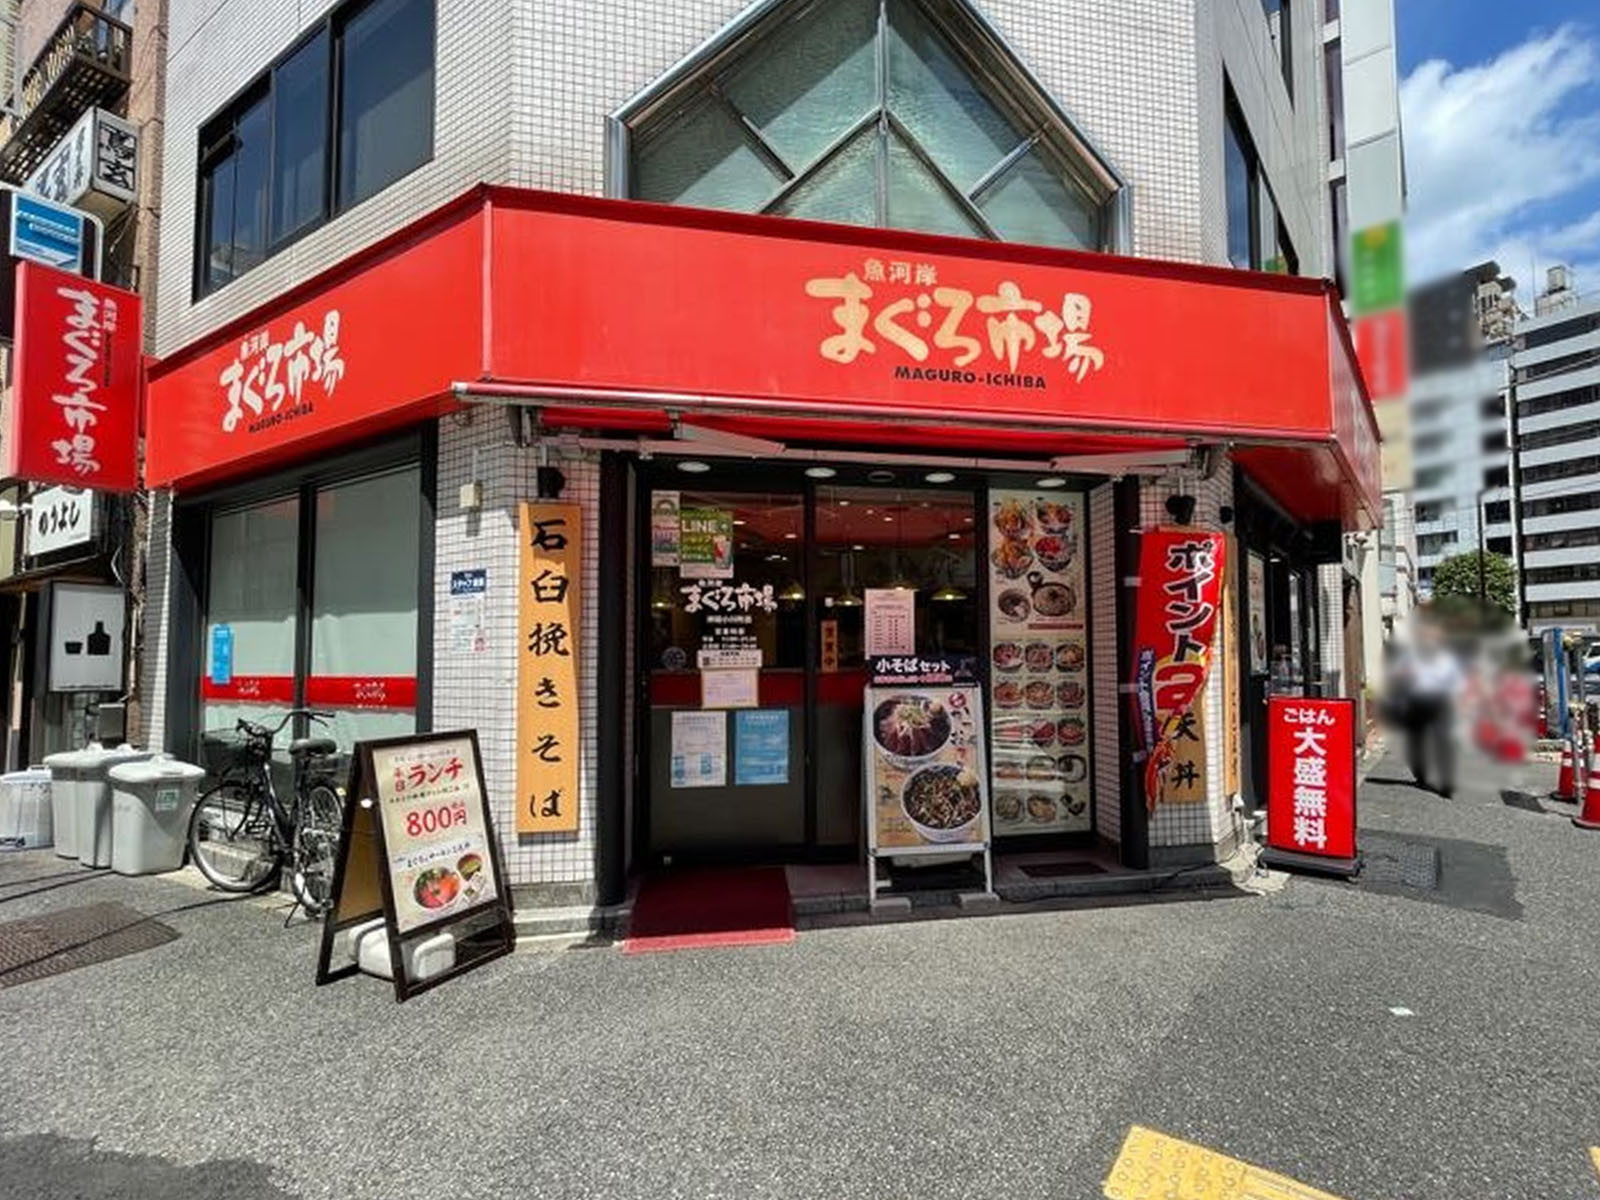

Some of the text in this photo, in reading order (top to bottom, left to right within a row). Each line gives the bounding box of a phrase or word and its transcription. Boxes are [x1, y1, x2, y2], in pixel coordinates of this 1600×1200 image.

[863, 257, 938, 287] 魚河岸
[804, 272, 1105, 384] まぐろ市場
[51, 287, 108, 475] まぐろ市場
[219, 309, 345, 432] まぐろ市場
[893, 365, 1047, 390] MAGURO-ICHIBA
[681, 519, 718, 533] LINE
[679, 582, 779, 614] まぐろ市場
[528, 518, 571, 819] 石臼挽きそば
[875, 657, 951, 673] 小そばセット
[1283, 707, 1336, 726] ごはん
[408, 757, 464, 789] ランチ
[1293, 726, 1328, 850] 大盛無料
[407, 807, 467, 837] 800円
